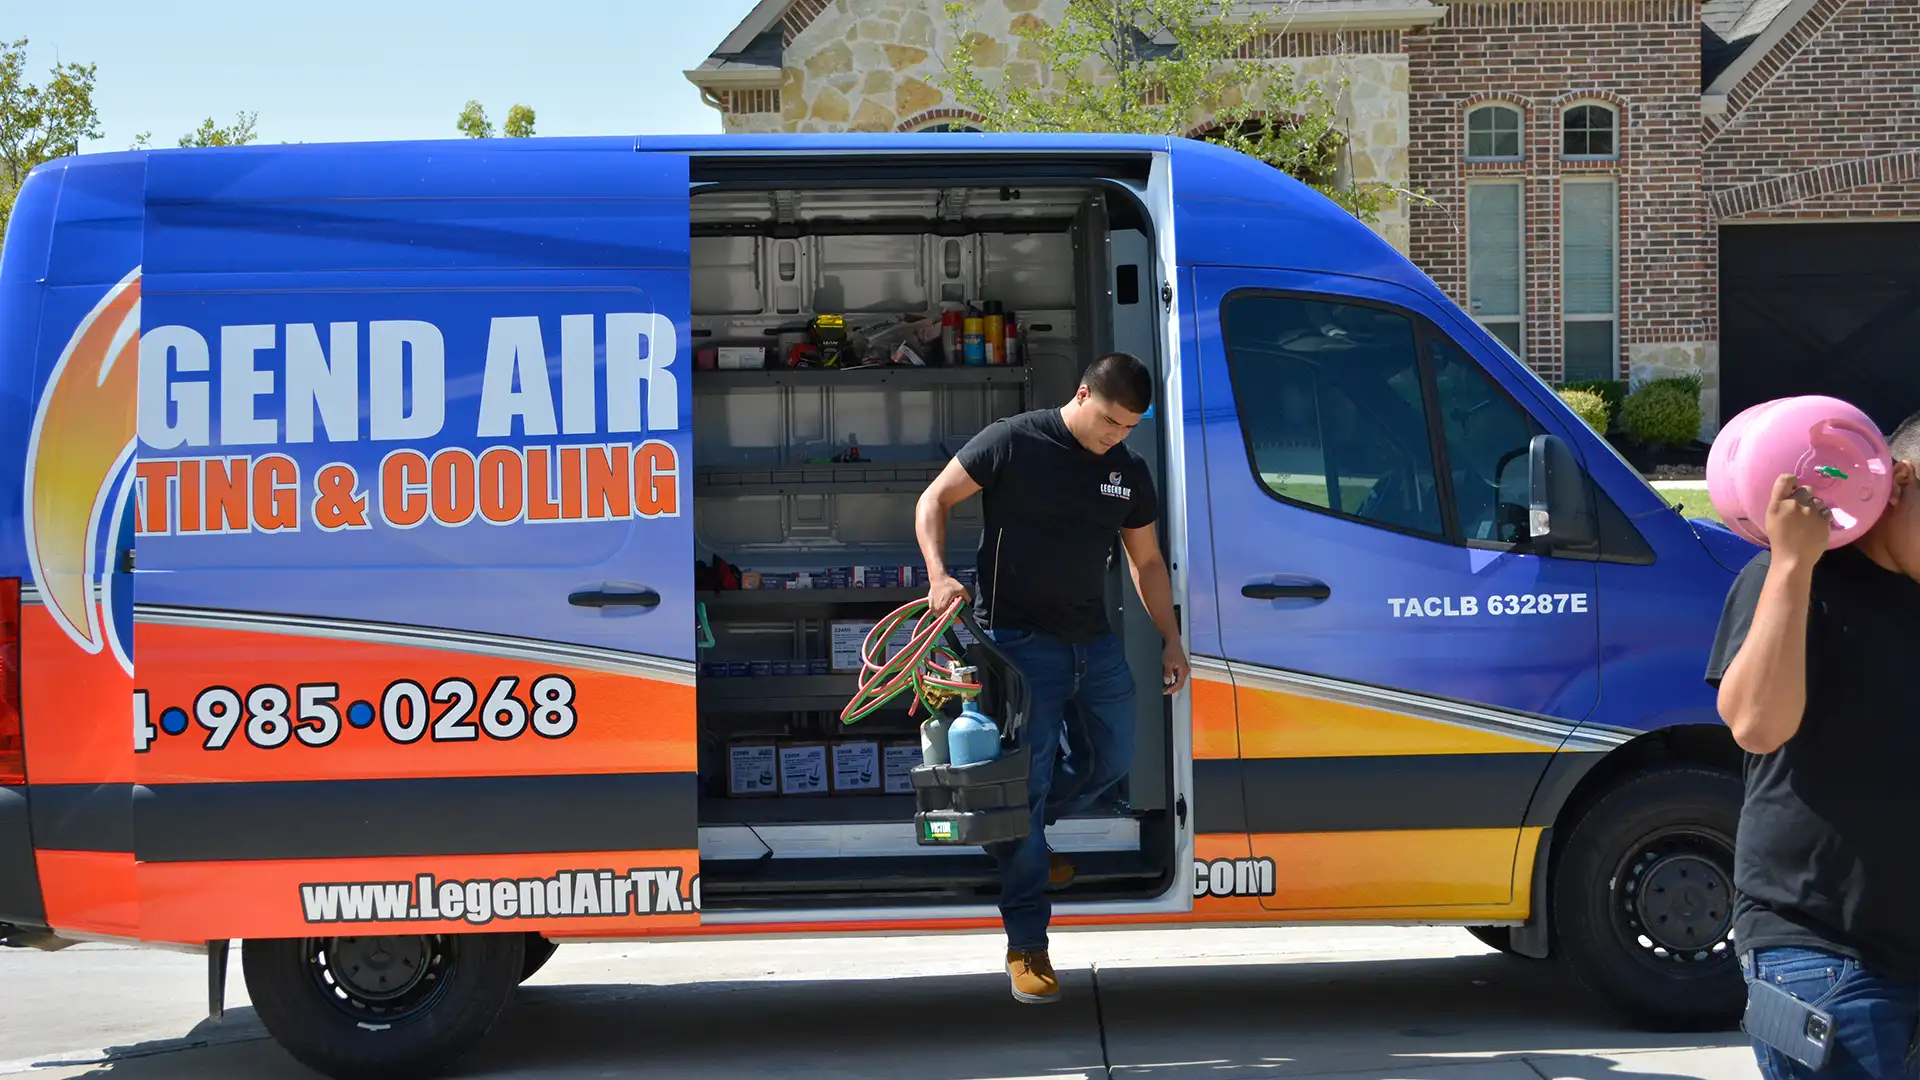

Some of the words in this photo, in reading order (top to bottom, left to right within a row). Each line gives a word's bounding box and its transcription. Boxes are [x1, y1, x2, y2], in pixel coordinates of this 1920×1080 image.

[137, 320, 446, 450] GEND
[476, 312, 679, 437] AIR
[135, 453, 301, 536] TING
[311, 461, 374, 533] &
[378, 438, 681, 530] COOLING
[1100, 483, 1122, 495] LEGEND
[1387, 596, 1479, 618] TACLB
[1487, 593, 1588, 616] 63287E
[930, 821, 951, 833] VICTOR
[299, 866, 700, 925] www.LegendAirTX.
